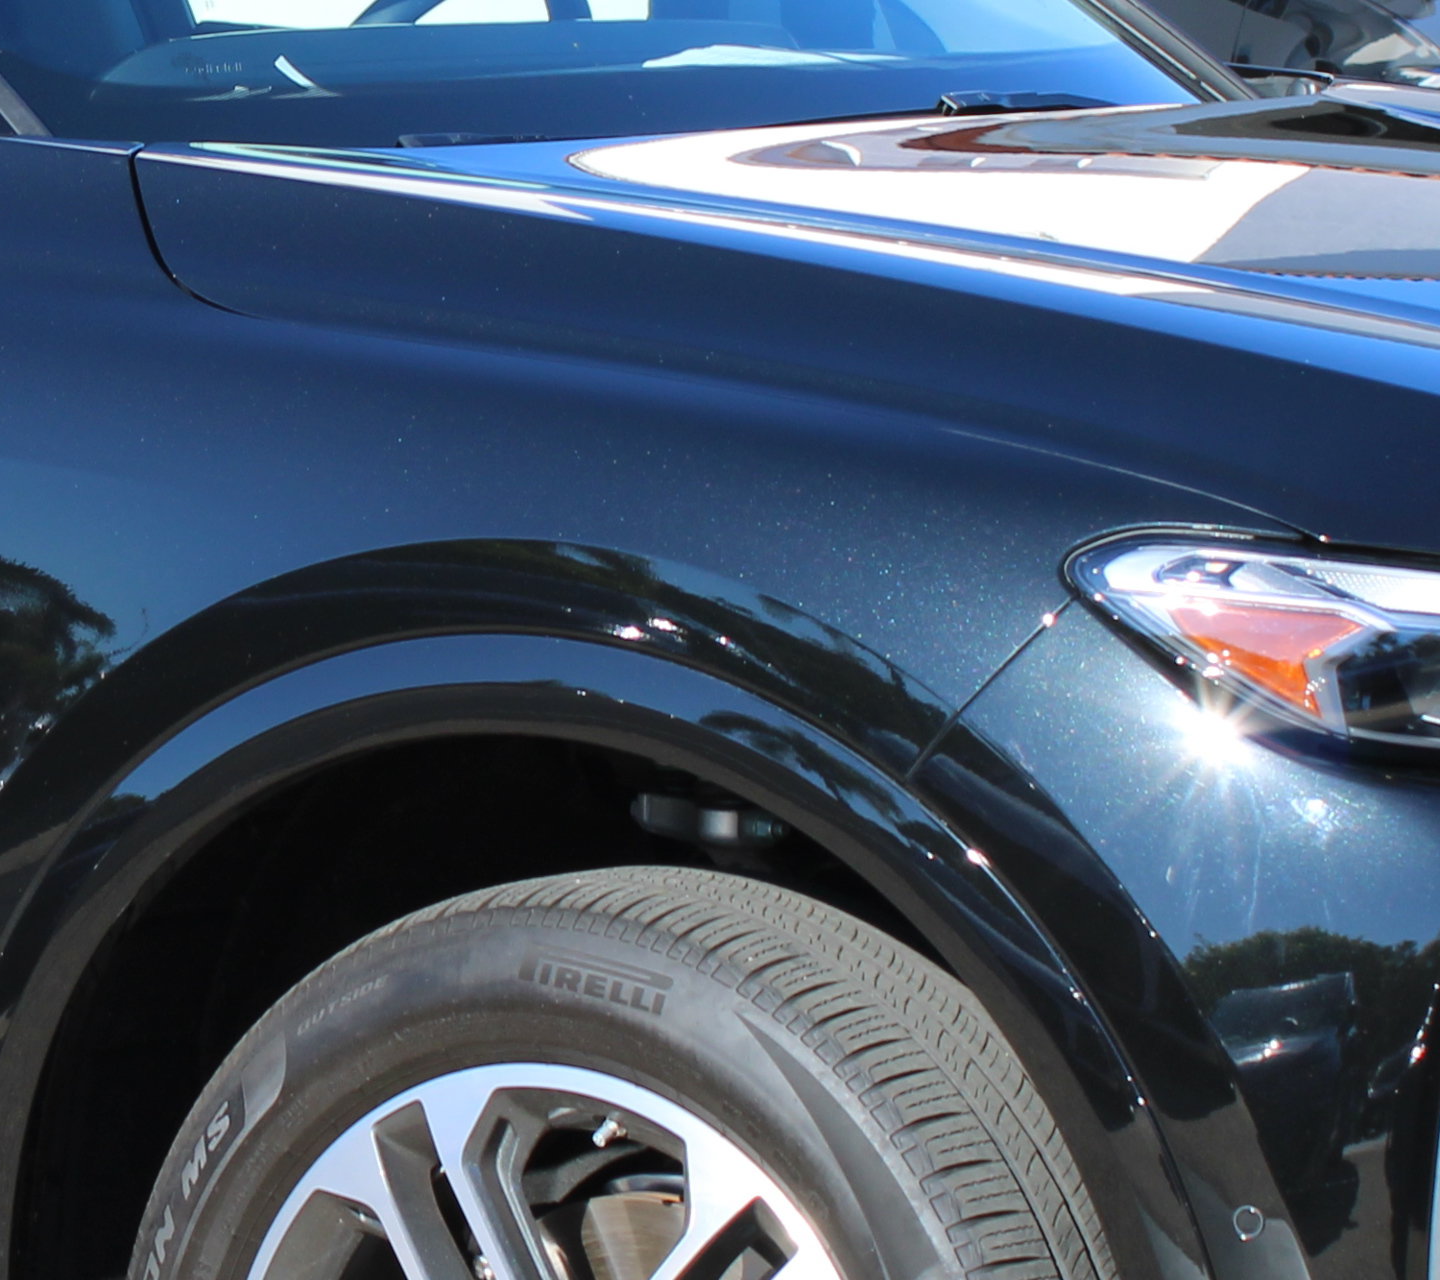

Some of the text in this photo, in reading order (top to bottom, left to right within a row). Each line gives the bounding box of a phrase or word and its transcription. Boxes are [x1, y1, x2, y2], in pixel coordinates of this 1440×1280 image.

[297, 974, 388, 1036] OUTSIDE
[520, 942, 673, 1017] PIRELLI
[181, 1101, 230, 1200] MS
